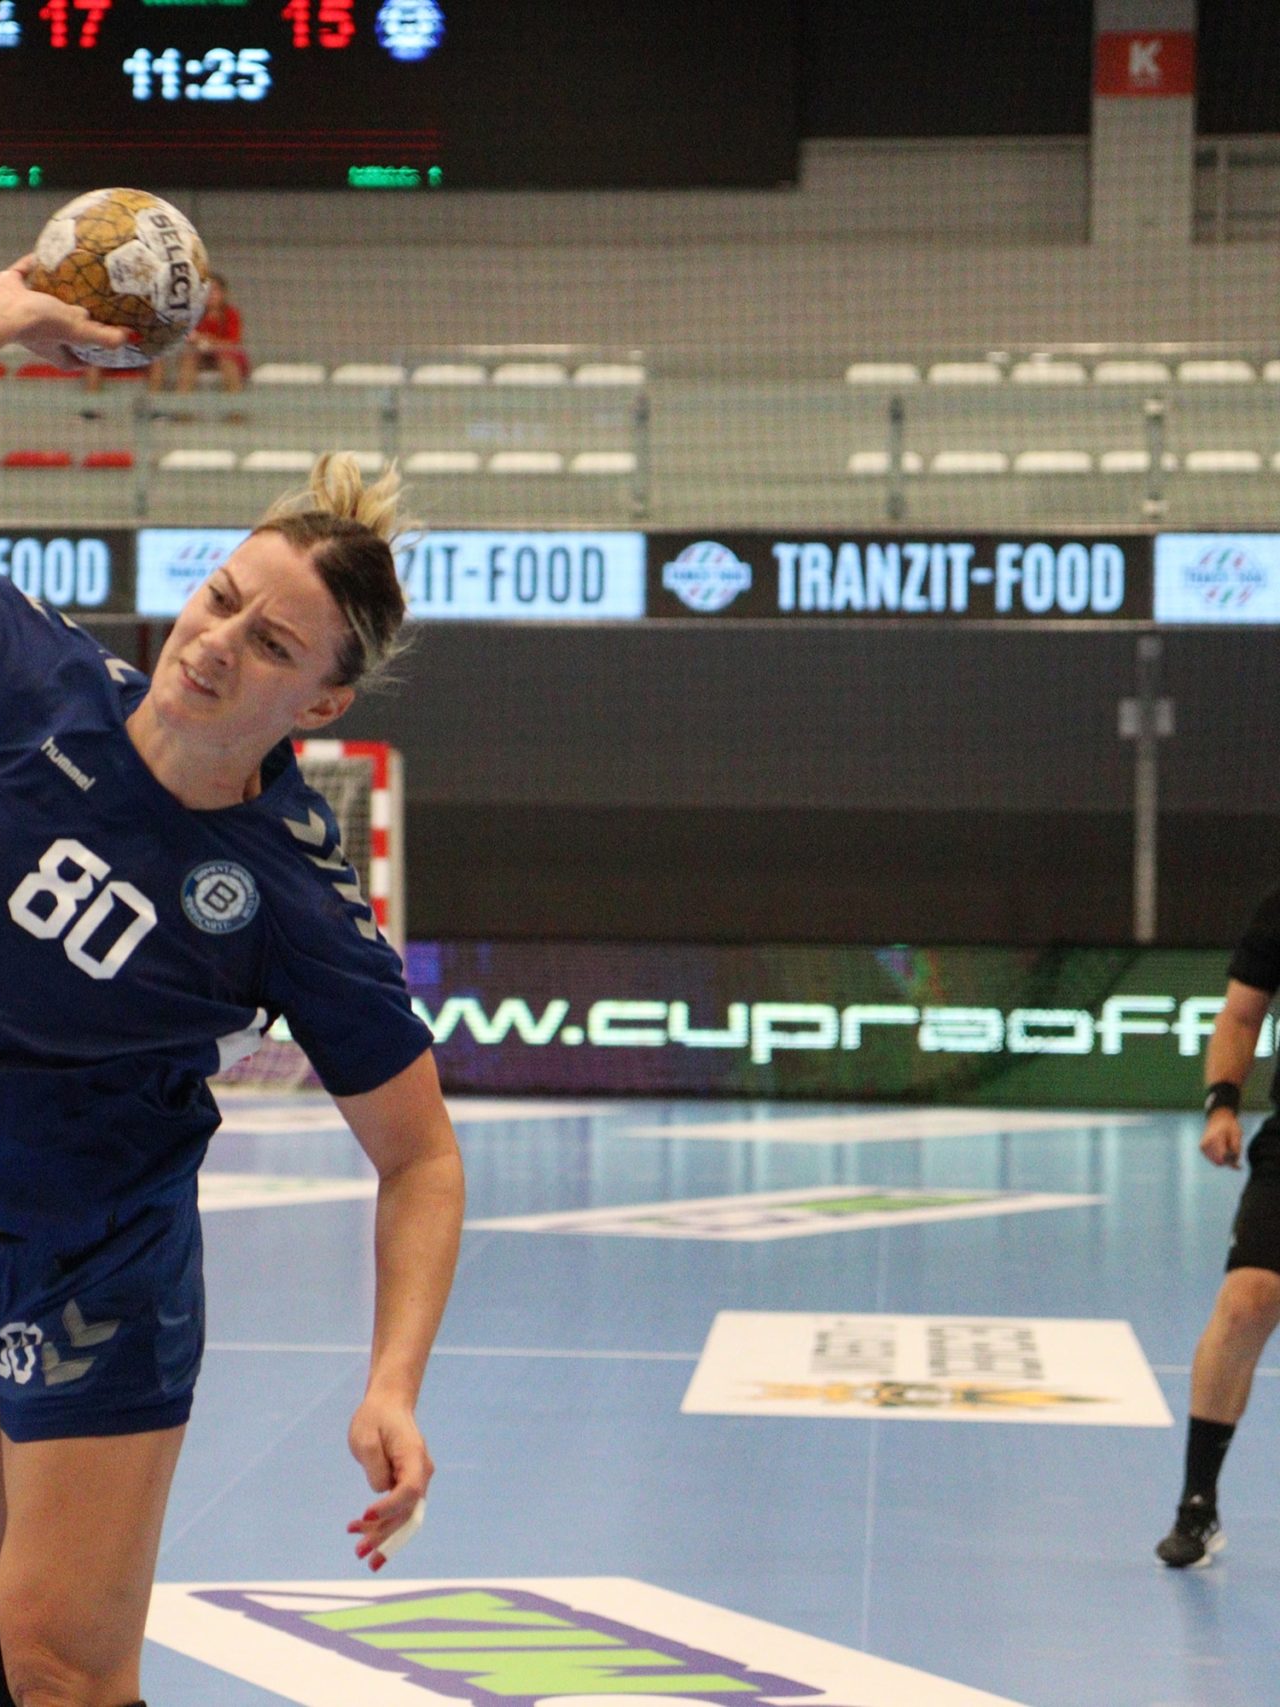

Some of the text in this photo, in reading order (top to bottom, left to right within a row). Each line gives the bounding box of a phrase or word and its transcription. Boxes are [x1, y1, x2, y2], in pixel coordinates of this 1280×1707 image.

[39, 0, 111, 48] 17
[281, 0, 355, 48] 15
[122, 48, 274, 100] 11:25
[1129, 40, 1162, 84] K
[149, 214, 190, 311] SELECT
[773, 543, 1125, 613] TRANZIT-FOOD
[40, 736, 96, 791] hummel
[8, 838, 158, 980] 80
